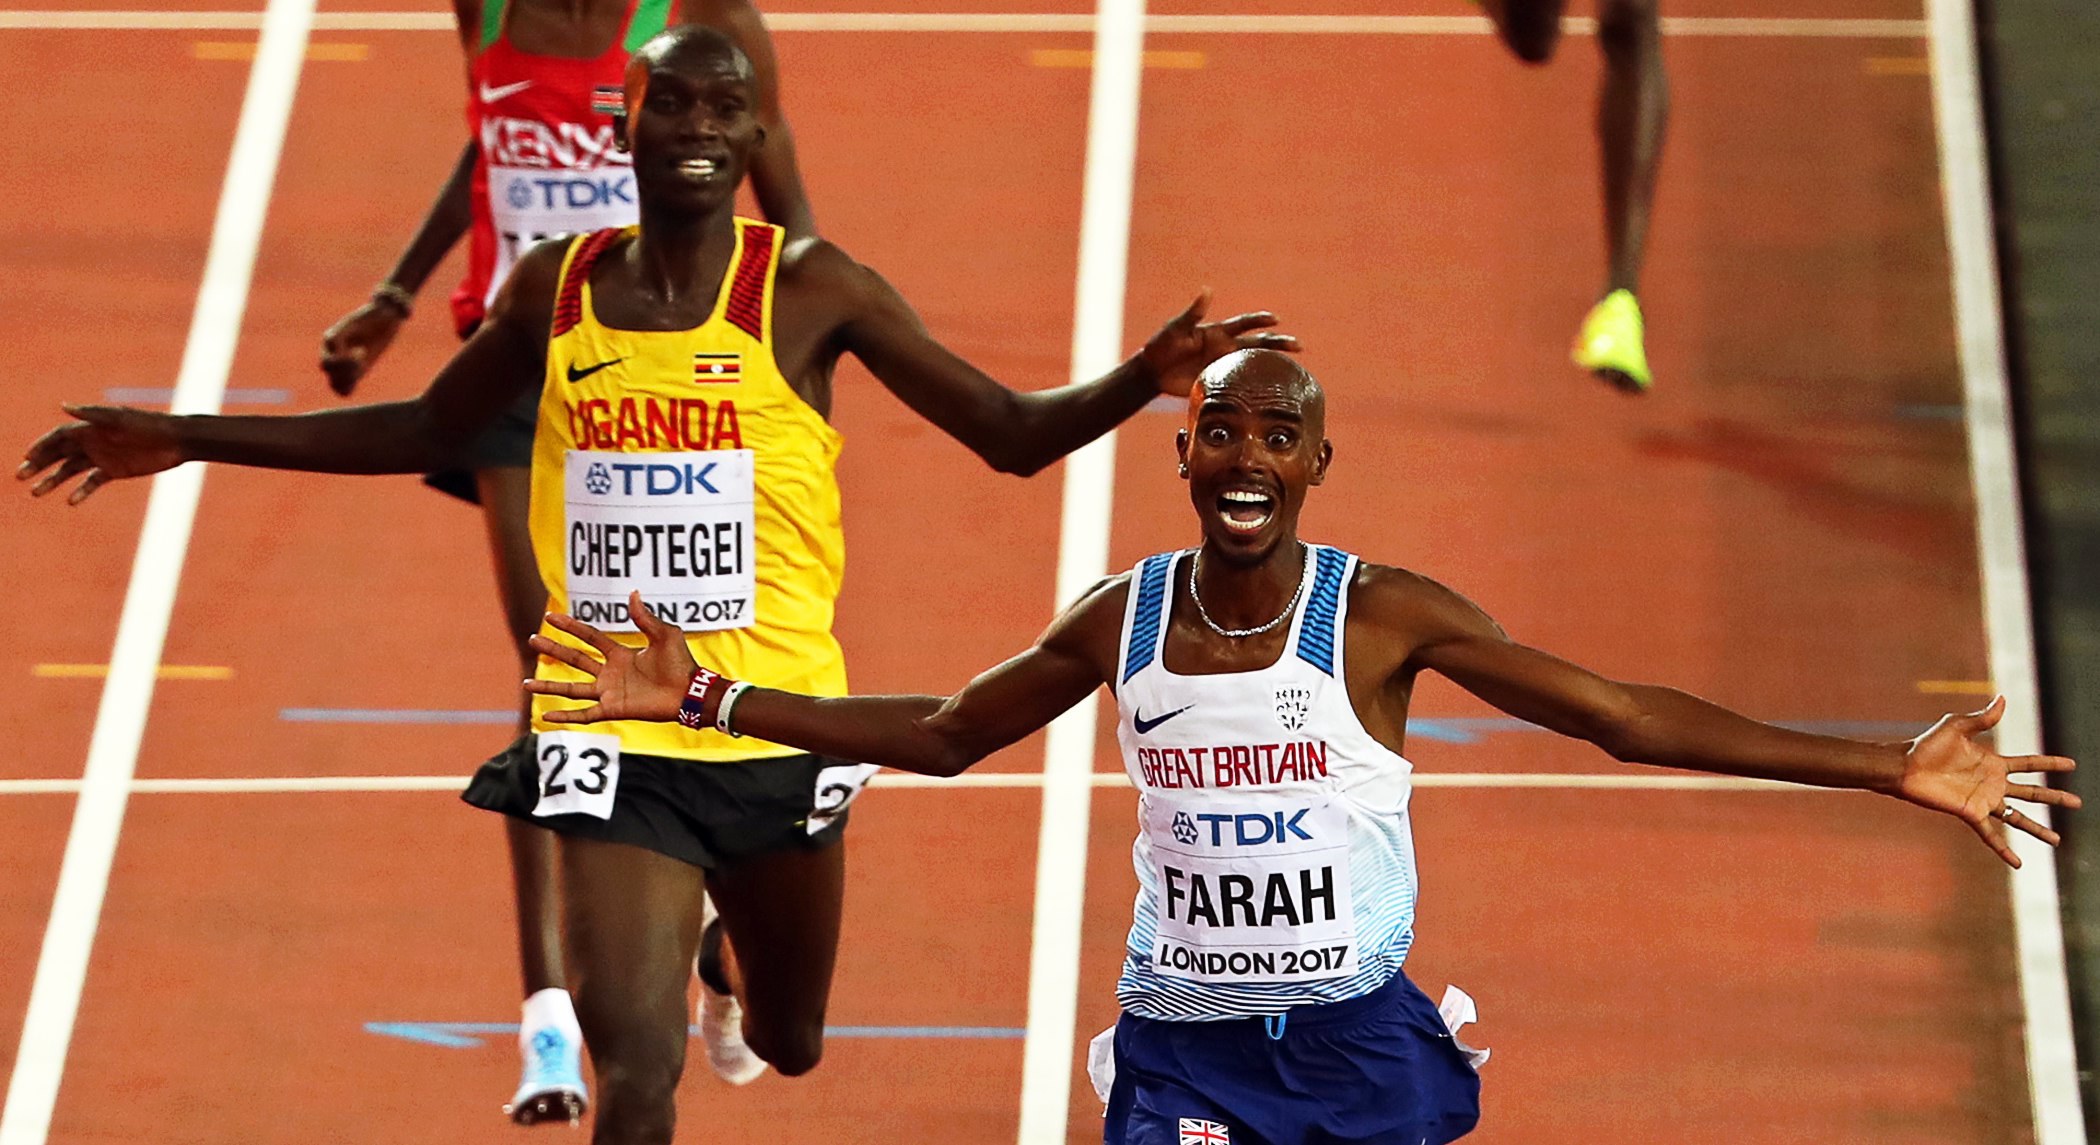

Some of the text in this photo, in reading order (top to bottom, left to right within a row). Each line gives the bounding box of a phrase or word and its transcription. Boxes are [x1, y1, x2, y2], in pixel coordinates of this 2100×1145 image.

[534, 177, 634, 209] TDK
[563, 397, 743, 450] UGANDA
[612, 462, 720, 495] TDK
[570, 521, 742, 578] CHEPTEGEI
[684, 599, 746, 623] 2017
[688, 668, 717, 698] MO
[541, 744, 609, 797] 23
[1138, 741, 1328, 788] GREAT BRITAIN
[1197, 808, 1314, 847] TDK
[1164, 865, 1336, 927] FARAH
[1160, 943, 1349, 975] LONDON 2017
